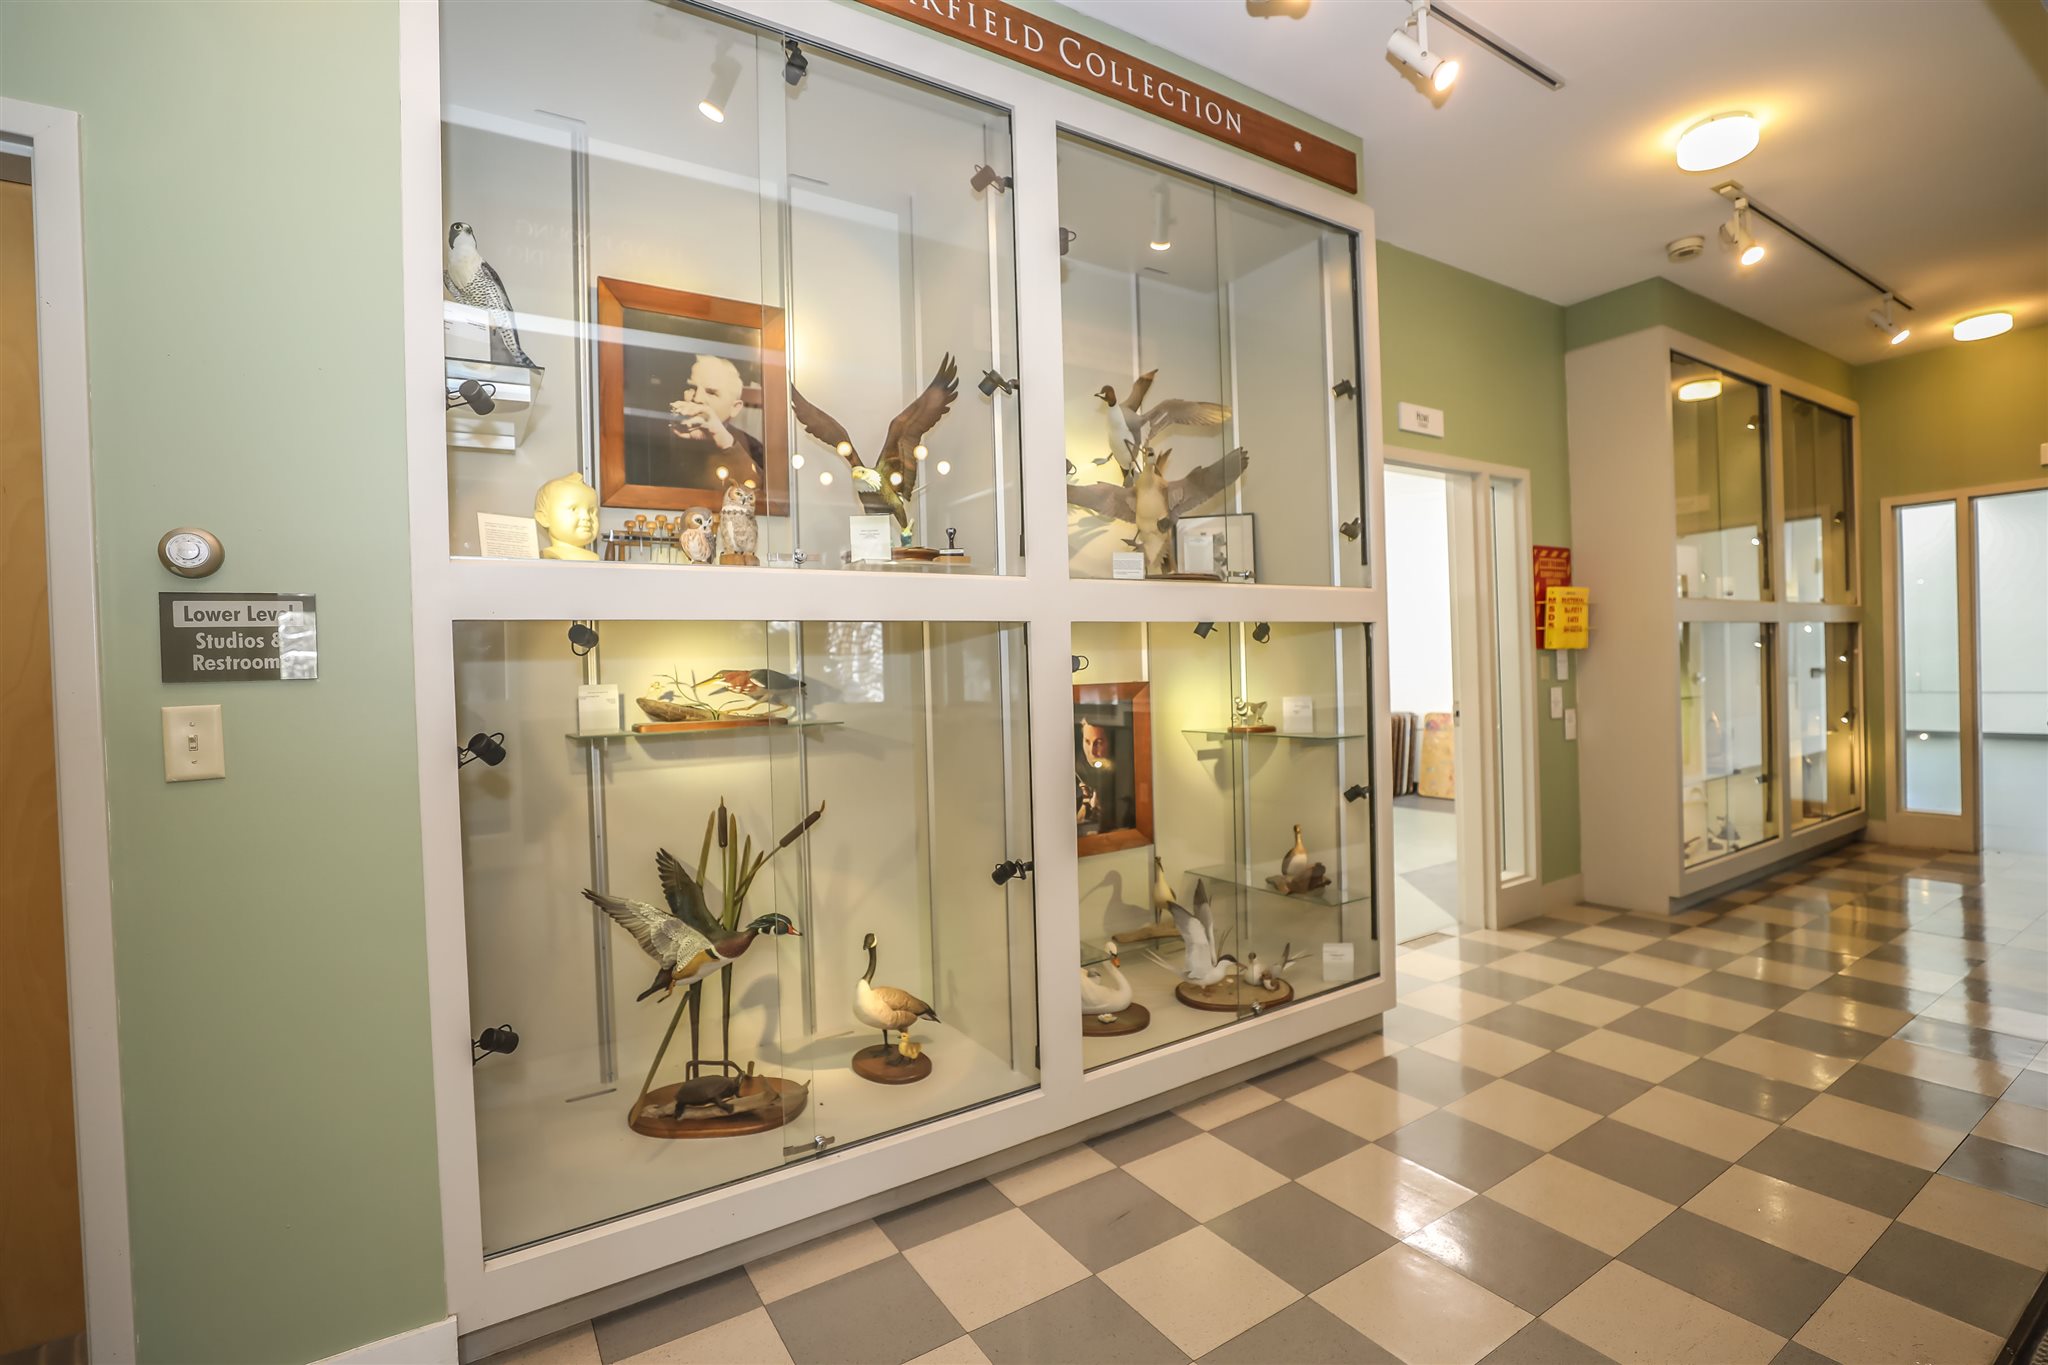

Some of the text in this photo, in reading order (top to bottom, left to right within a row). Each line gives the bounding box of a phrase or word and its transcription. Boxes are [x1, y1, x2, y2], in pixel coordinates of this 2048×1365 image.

[906, 0, 1044, 53] RFIELD
[183, 605, 241, 622] Lower
[196, 631, 281, 650] Studios &
